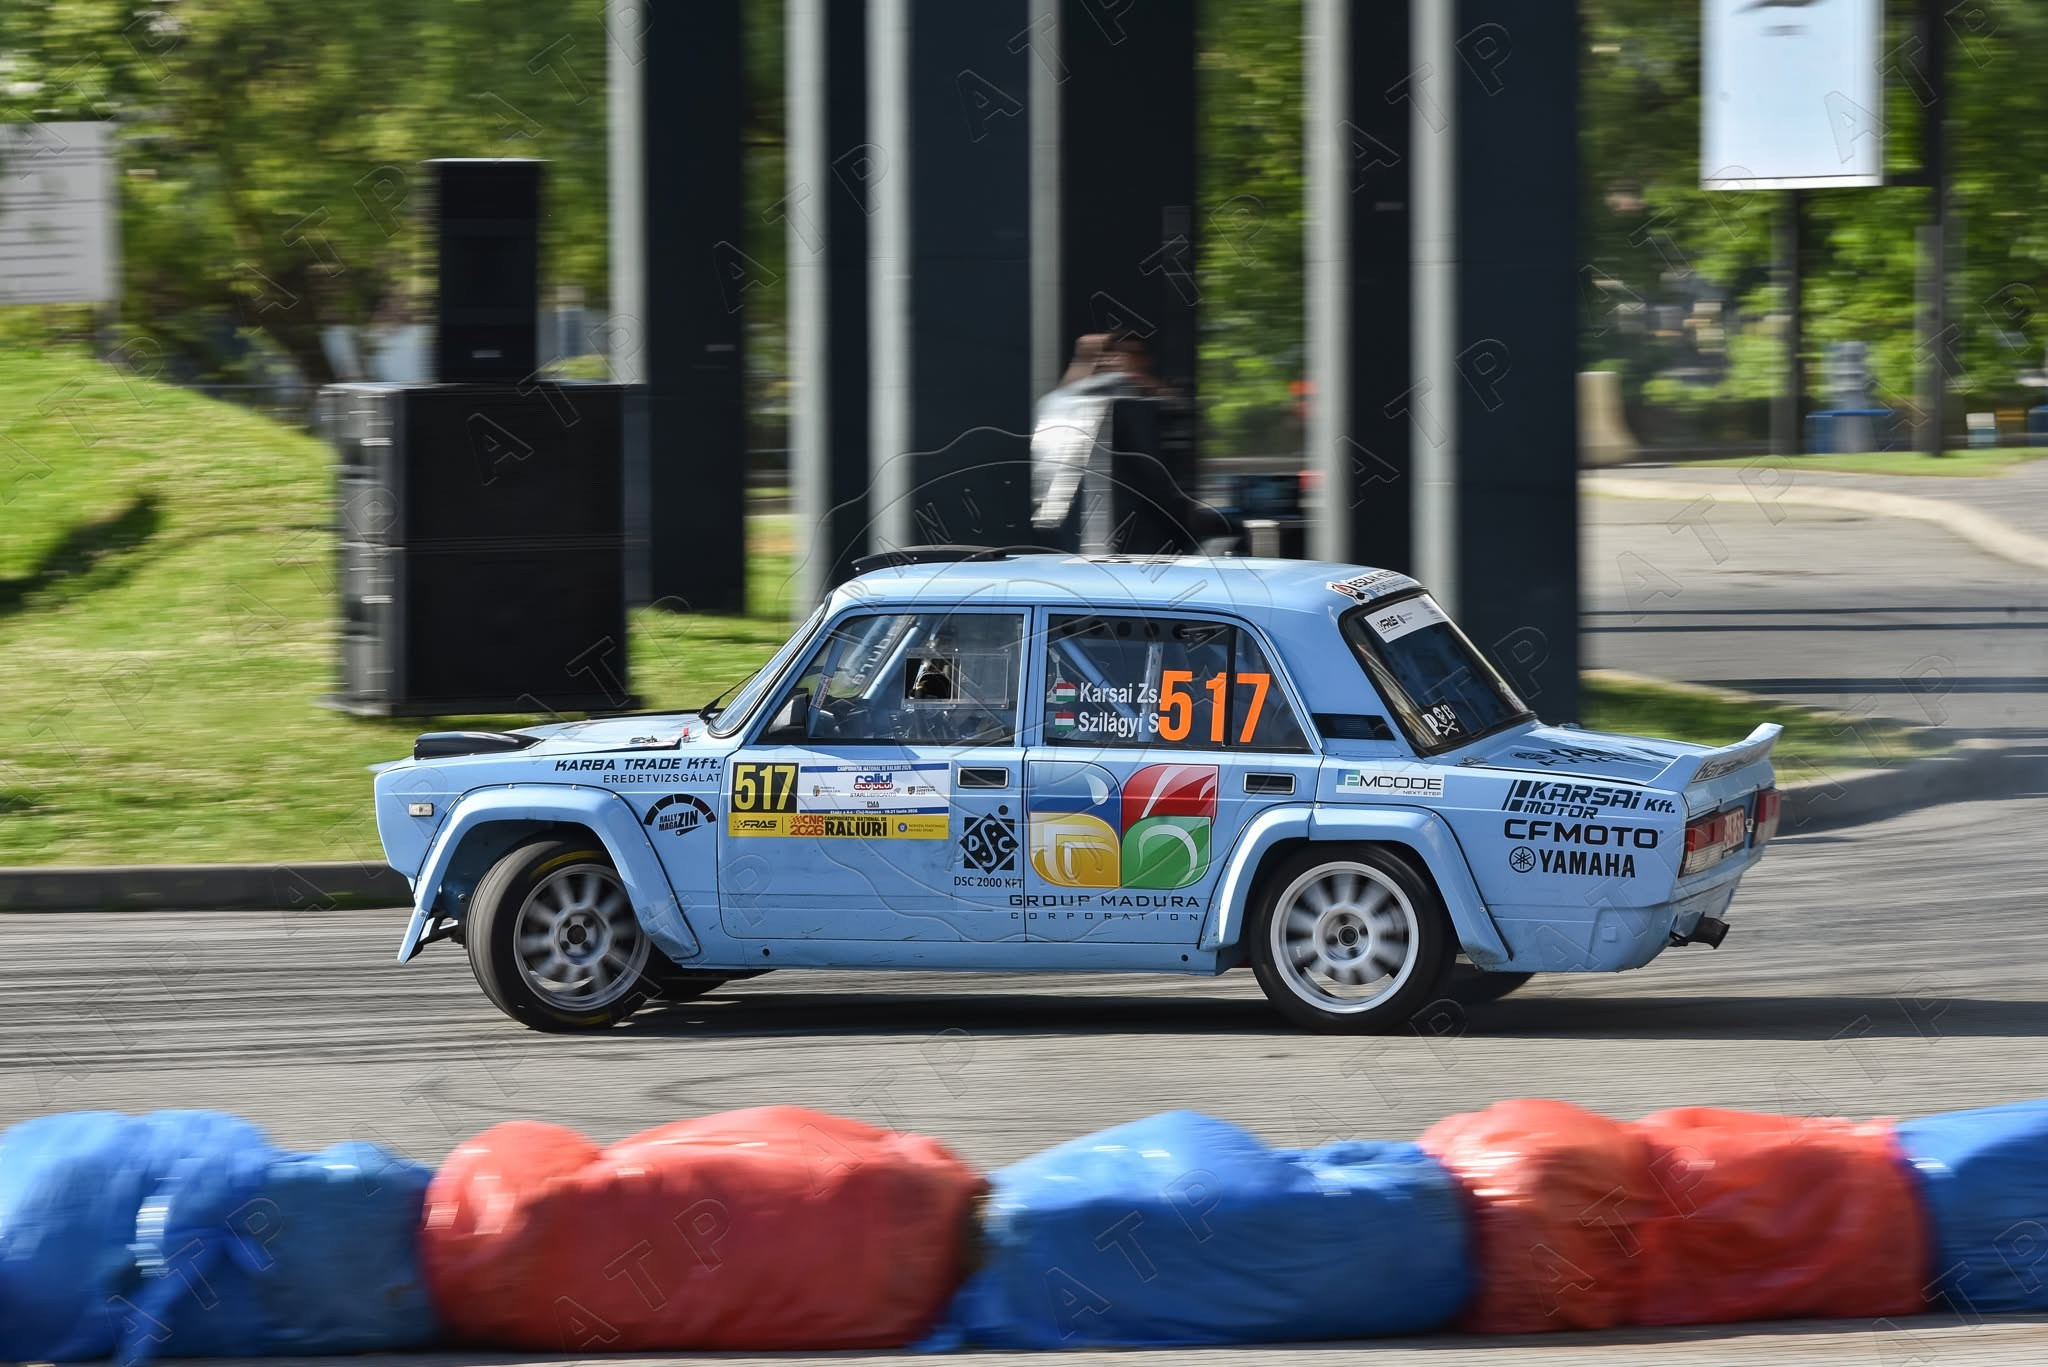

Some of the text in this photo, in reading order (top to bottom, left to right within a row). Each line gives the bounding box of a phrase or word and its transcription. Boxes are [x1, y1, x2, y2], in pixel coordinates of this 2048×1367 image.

[1079, 682, 1161, 704] Karsai Zs.
[1158, 670, 1271, 743] 517
[1078, 711, 1143, 738] Szilágyi
[555, 757, 722, 771] KARBA TRADE Kft.
[603, 771, 721, 784] EREDETVIZSGÁLAT
[733, 764, 797, 811] 517
[1523, 801, 1599, 820] MOTOR
[1643, 798, 1676, 815] Kft.
[659, 813, 678, 824] RALLY
[742, 820, 777, 828] FRAS
[802, 815, 824, 825] CNR
[789, 825, 824, 836] 2026
[825, 821, 887, 836] RALIURI
[1503, 818, 1660, 849] CFMOTO
[1538, 849, 1636, 878] YAMAHA
[953, 876, 1024, 889] DSC 2000 KFT
[1009, 894, 1200, 908] GROUP MADURA
[1010, 912, 1199, 921] CORPORATION
